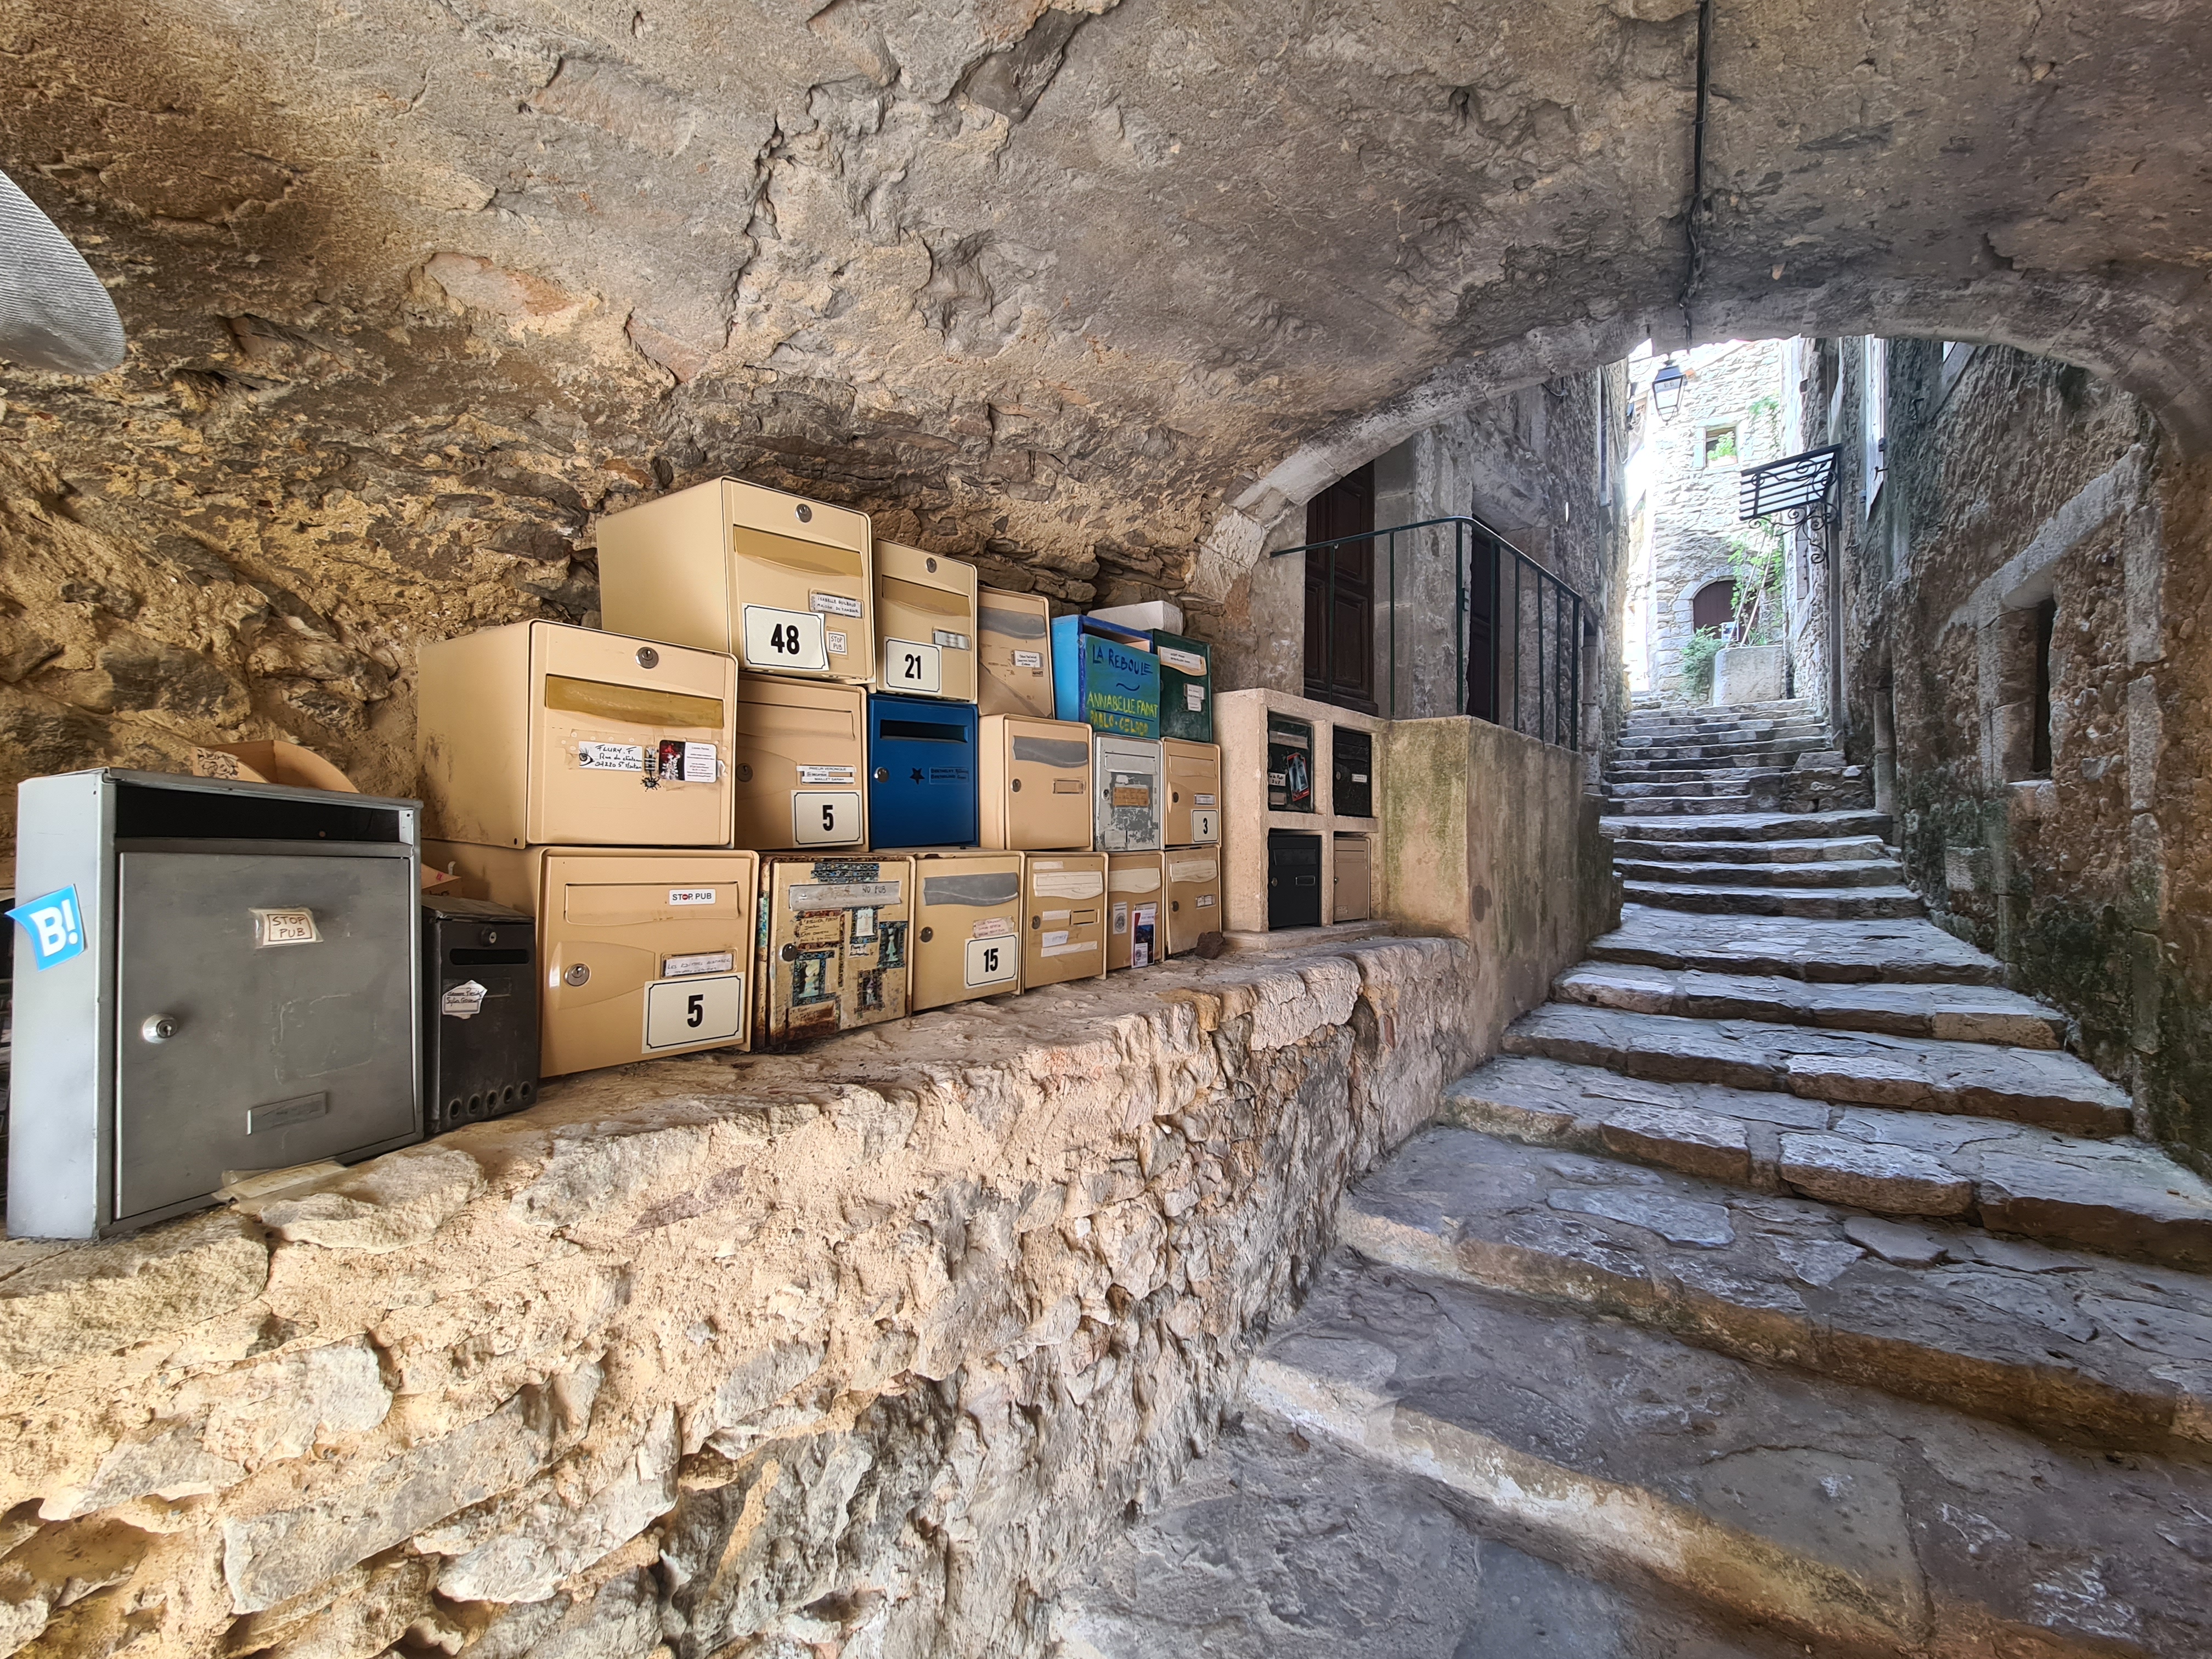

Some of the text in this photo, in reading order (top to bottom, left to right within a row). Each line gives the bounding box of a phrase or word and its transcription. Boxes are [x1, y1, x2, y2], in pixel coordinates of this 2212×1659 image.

[771, 623, 800, 654] 48
[905, 653, 921, 680] 21
[1092, 644, 1153, 675] LA REBOULE
[1087, 691, 1158, 718] ANNABELLE FADAT
[822, 804, 834, 831] 5
[1203, 817, 1208, 834] 3
[862, 885, 871, 893] NO
[29, 899, 78, 957] B!
[272, 916, 305, 926] STOP
[279, 928, 305, 938] PUB
[984, 947, 998, 973] 15
[687, 994, 704, 1028] 5
